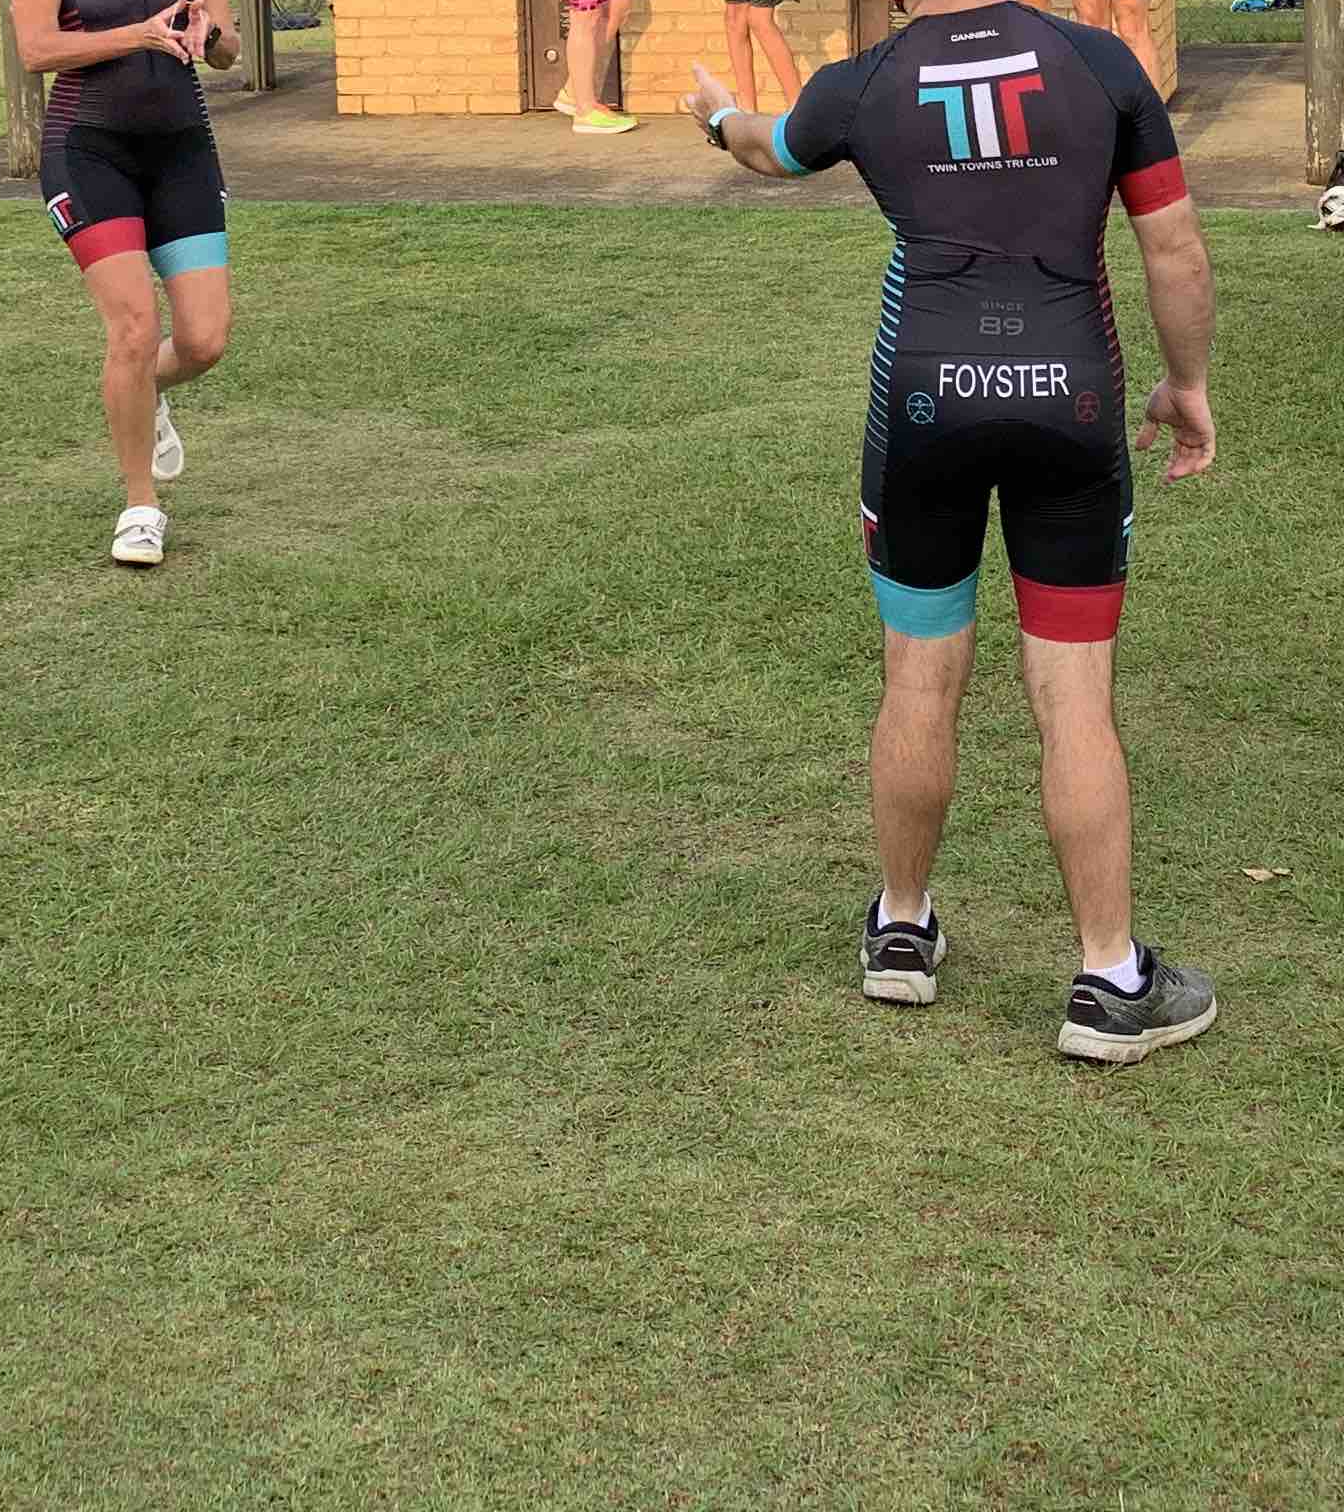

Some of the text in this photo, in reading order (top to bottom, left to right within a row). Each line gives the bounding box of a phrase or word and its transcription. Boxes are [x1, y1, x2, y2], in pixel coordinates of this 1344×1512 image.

[950, 29, 1000, 42] CANNIBAL
[927, 156, 1058, 174] TWIN TOWNS TRI CLUB
[979, 316, 1025, 336] 89
[938, 363, 1071, 399] FOYSTER
